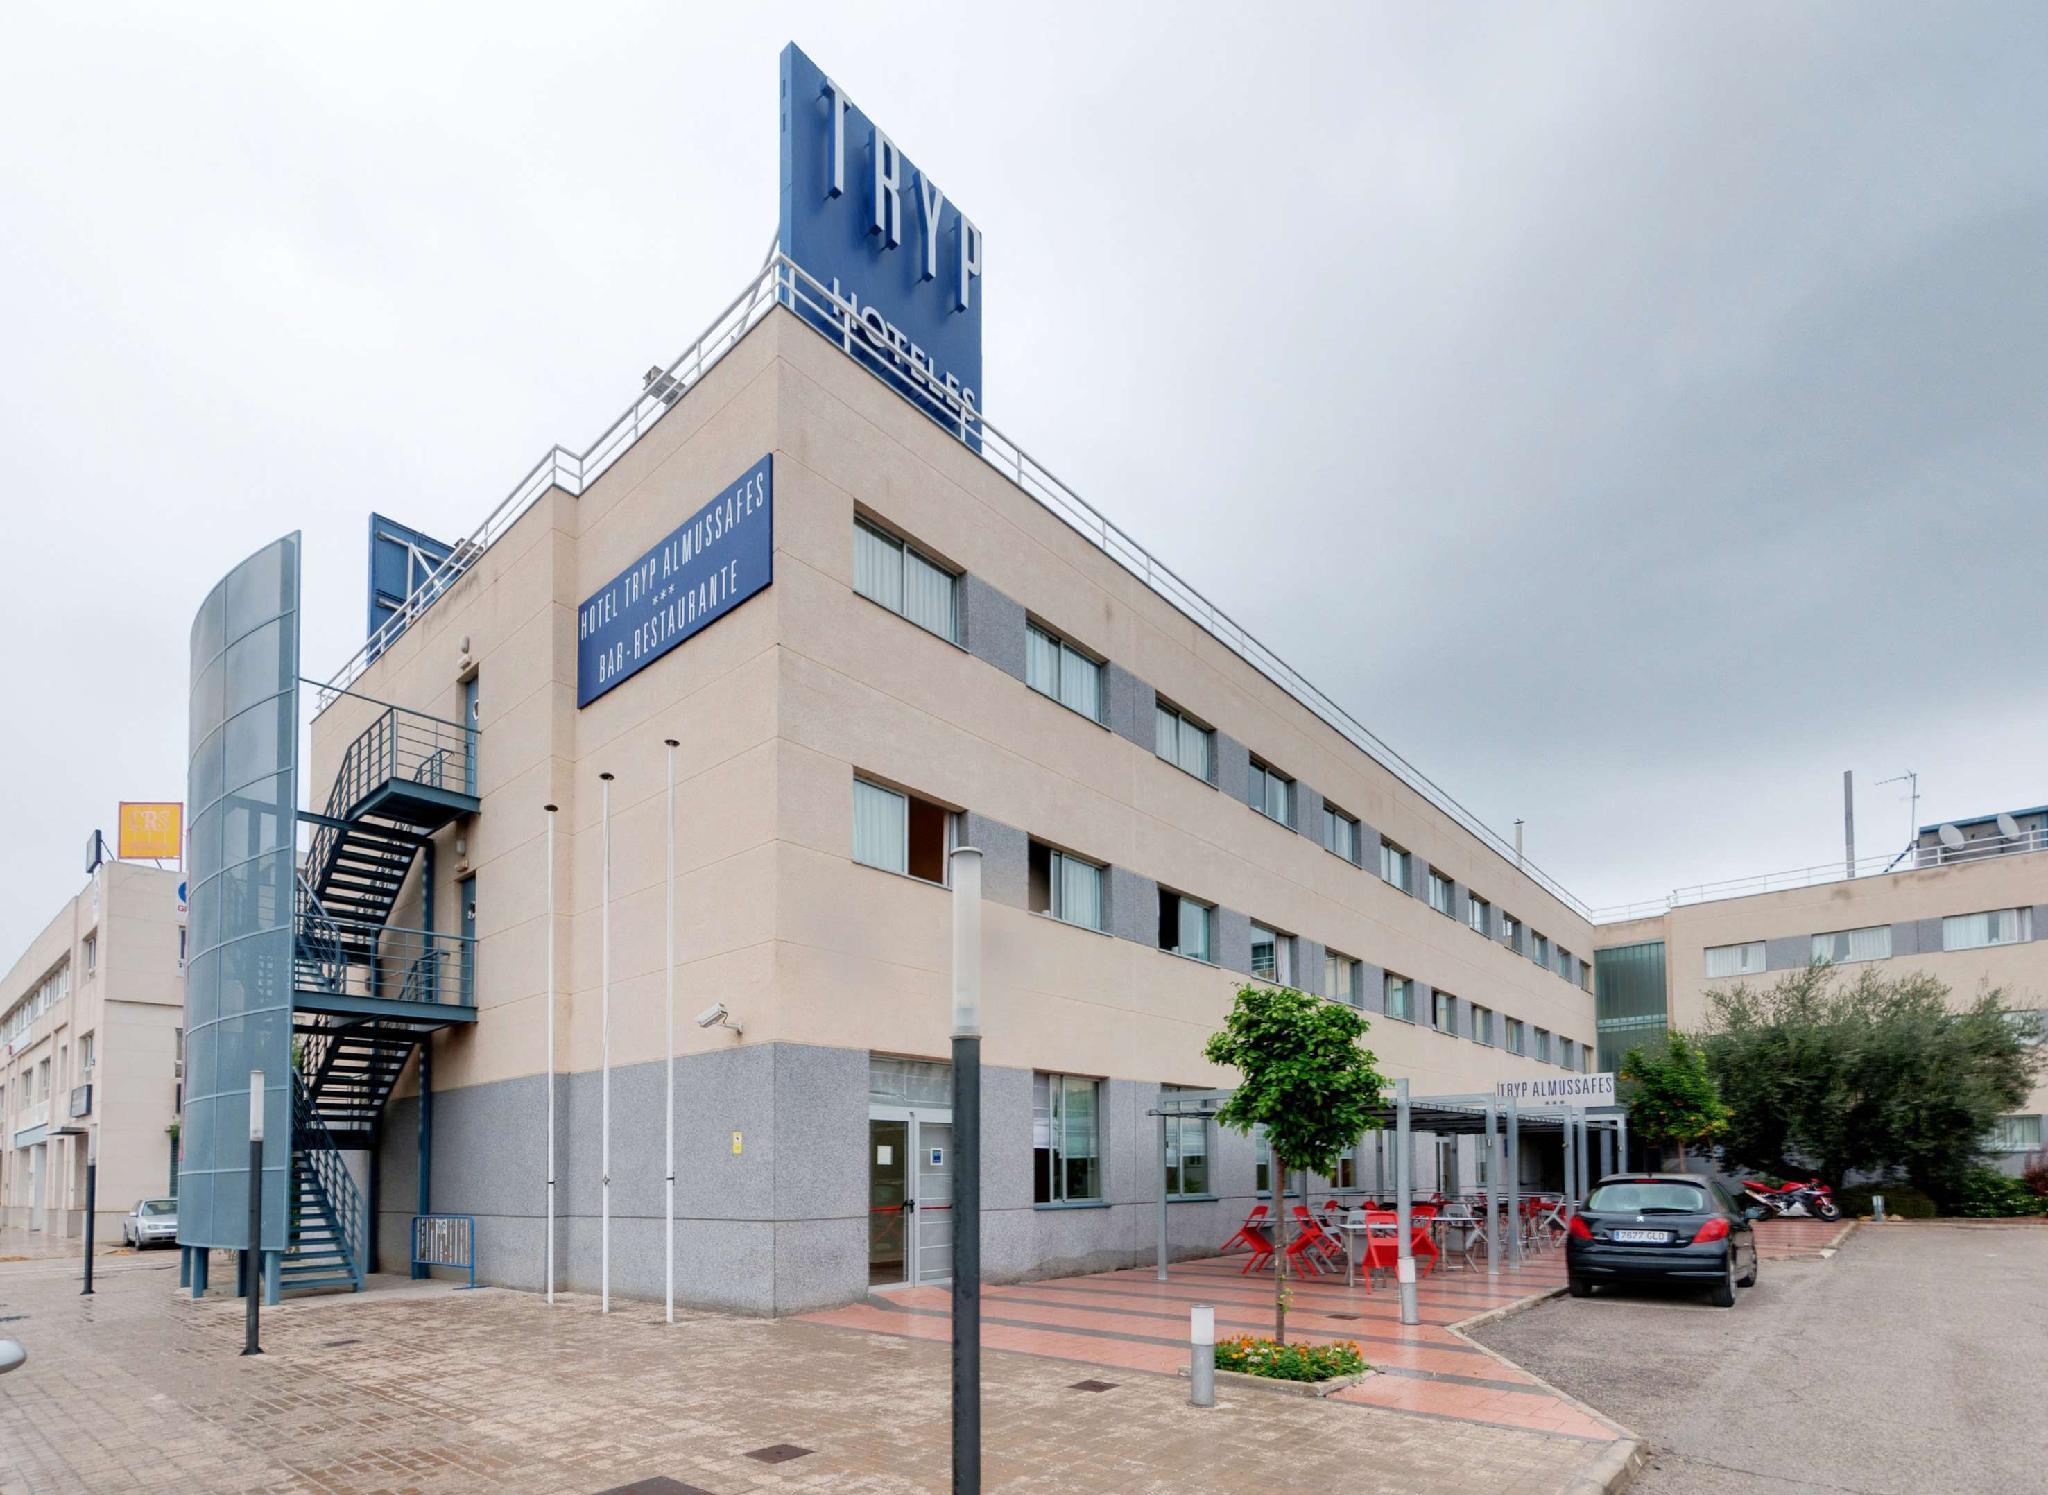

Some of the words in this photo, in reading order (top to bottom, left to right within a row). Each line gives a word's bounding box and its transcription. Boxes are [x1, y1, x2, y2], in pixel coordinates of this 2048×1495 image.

[826, 75, 982, 311] TRYP
[833, 276, 976, 422] HOTELES
[581, 589, 618, 640] HOTEL
[625, 558, 656, 608] TRYP
[663, 472, 763, 579] ALMUSSAFES
[1532, 1077, 1613, 1097] ALMUSSAFES
